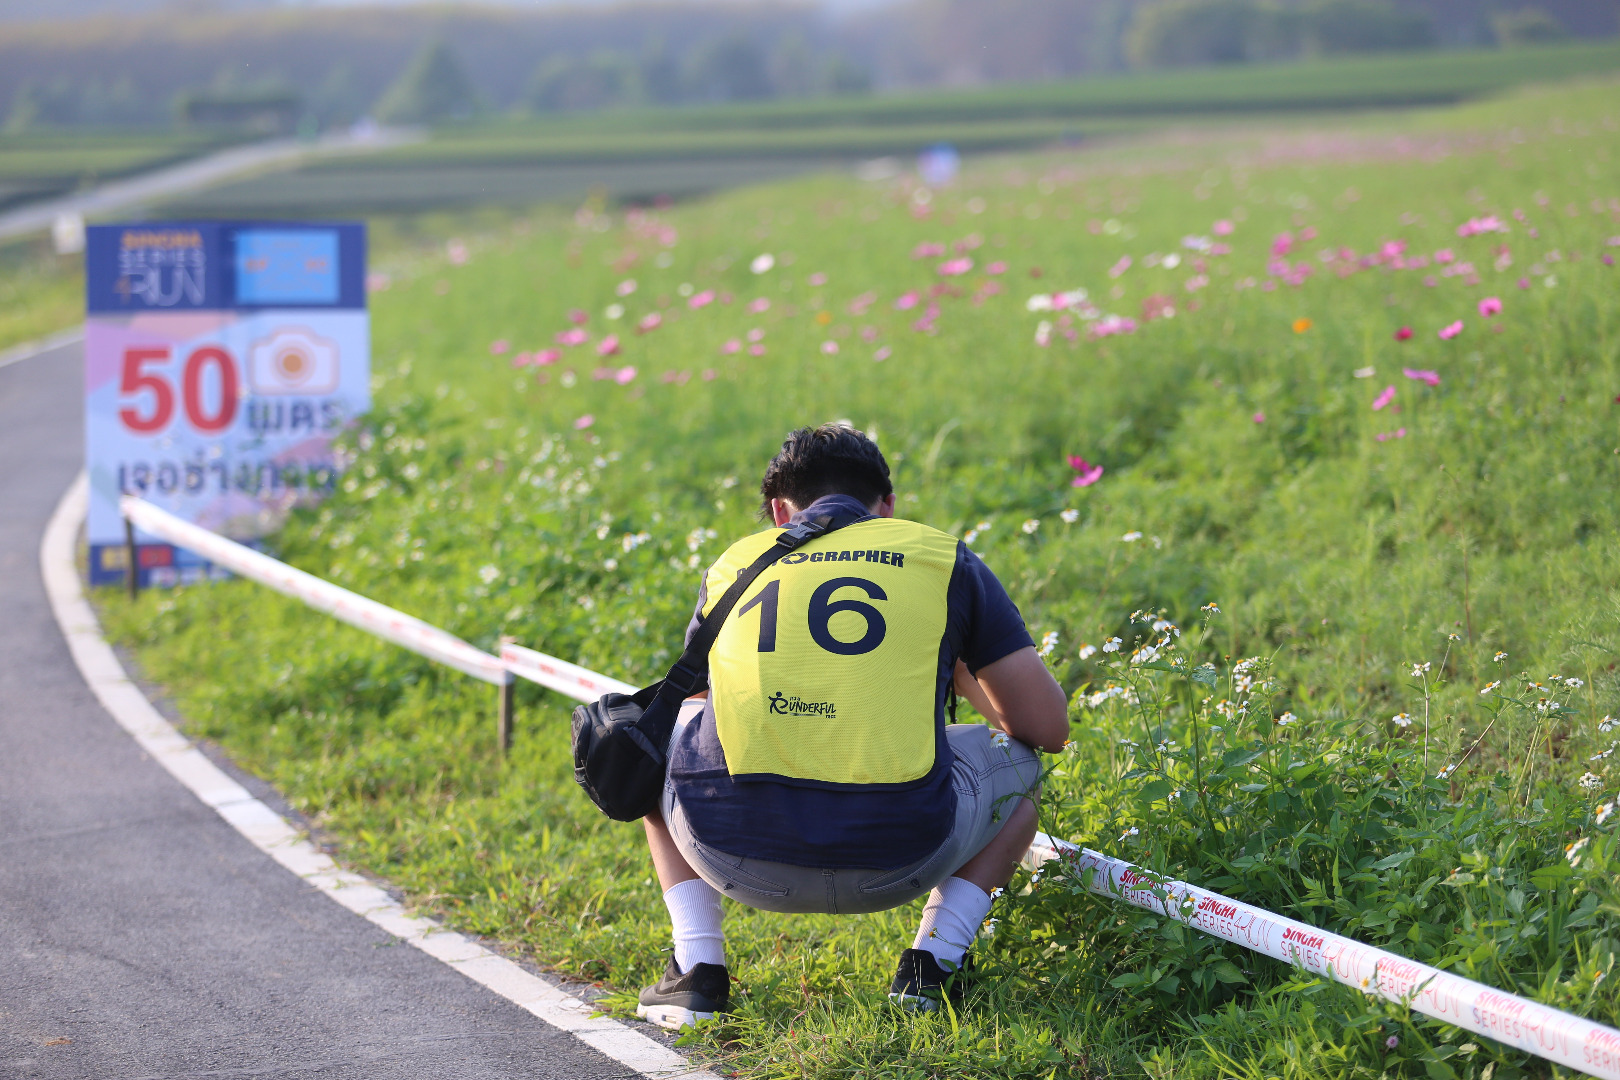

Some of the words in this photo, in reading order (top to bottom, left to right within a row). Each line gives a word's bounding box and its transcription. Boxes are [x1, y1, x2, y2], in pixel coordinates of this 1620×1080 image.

[118, 344, 240, 434] 50
[738, 576, 888, 655] 16
[1198, 897, 1238, 920] SINGHA
[1196, 911, 1233, 937] SERIES
[1282, 926, 1326, 950] SINGHA
[1376, 956, 1422, 983] SINGHA
[1474, 991, 1526, 1018] SINGHA
[1473, 1007, 1520, 1038] SERIES
